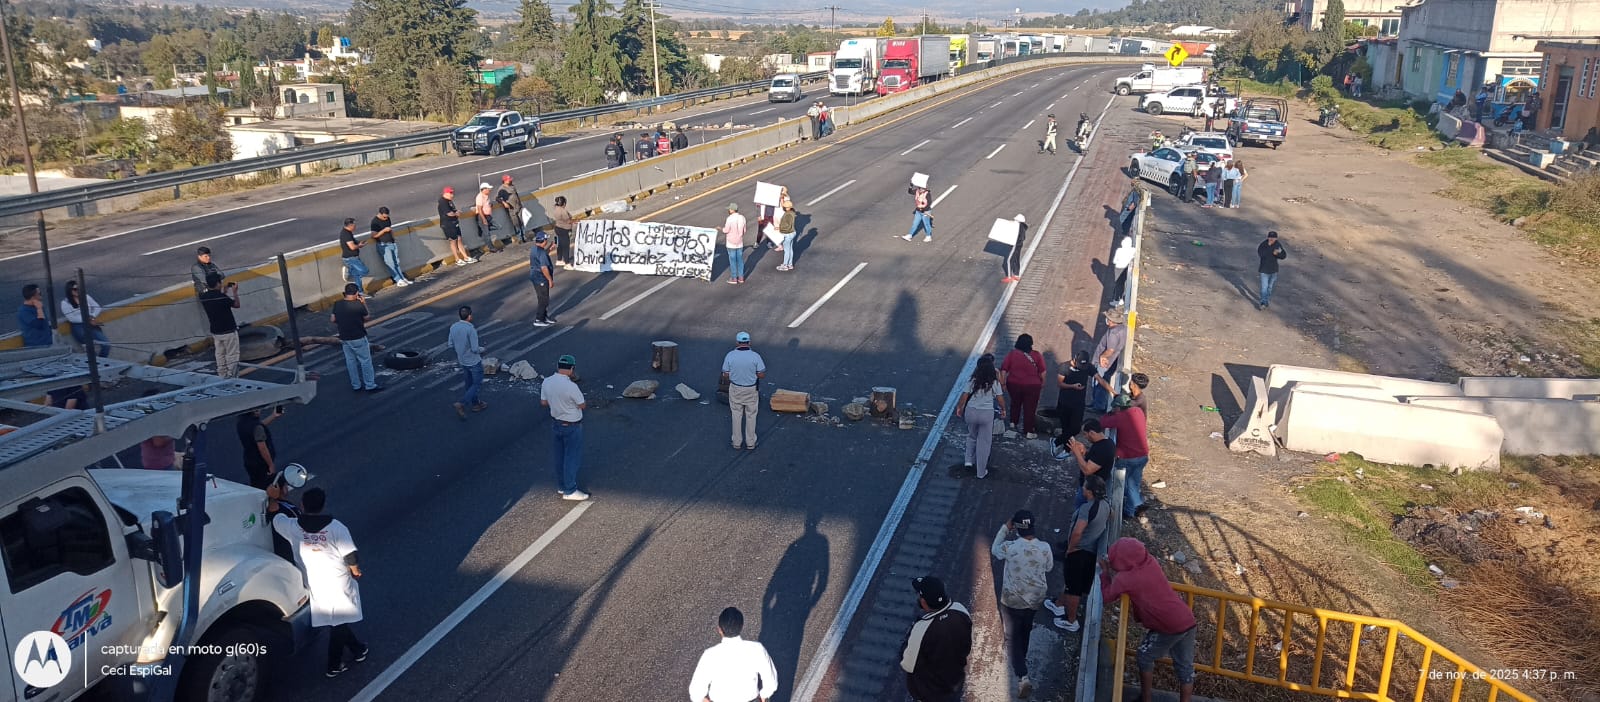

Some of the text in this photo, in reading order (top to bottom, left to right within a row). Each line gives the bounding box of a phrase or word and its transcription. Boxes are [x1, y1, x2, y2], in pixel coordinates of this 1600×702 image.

[577, 220, 631, 247] Malditos
[576, 248, 606, 265] David
[610, 247, 667, 265] Gonzalez
